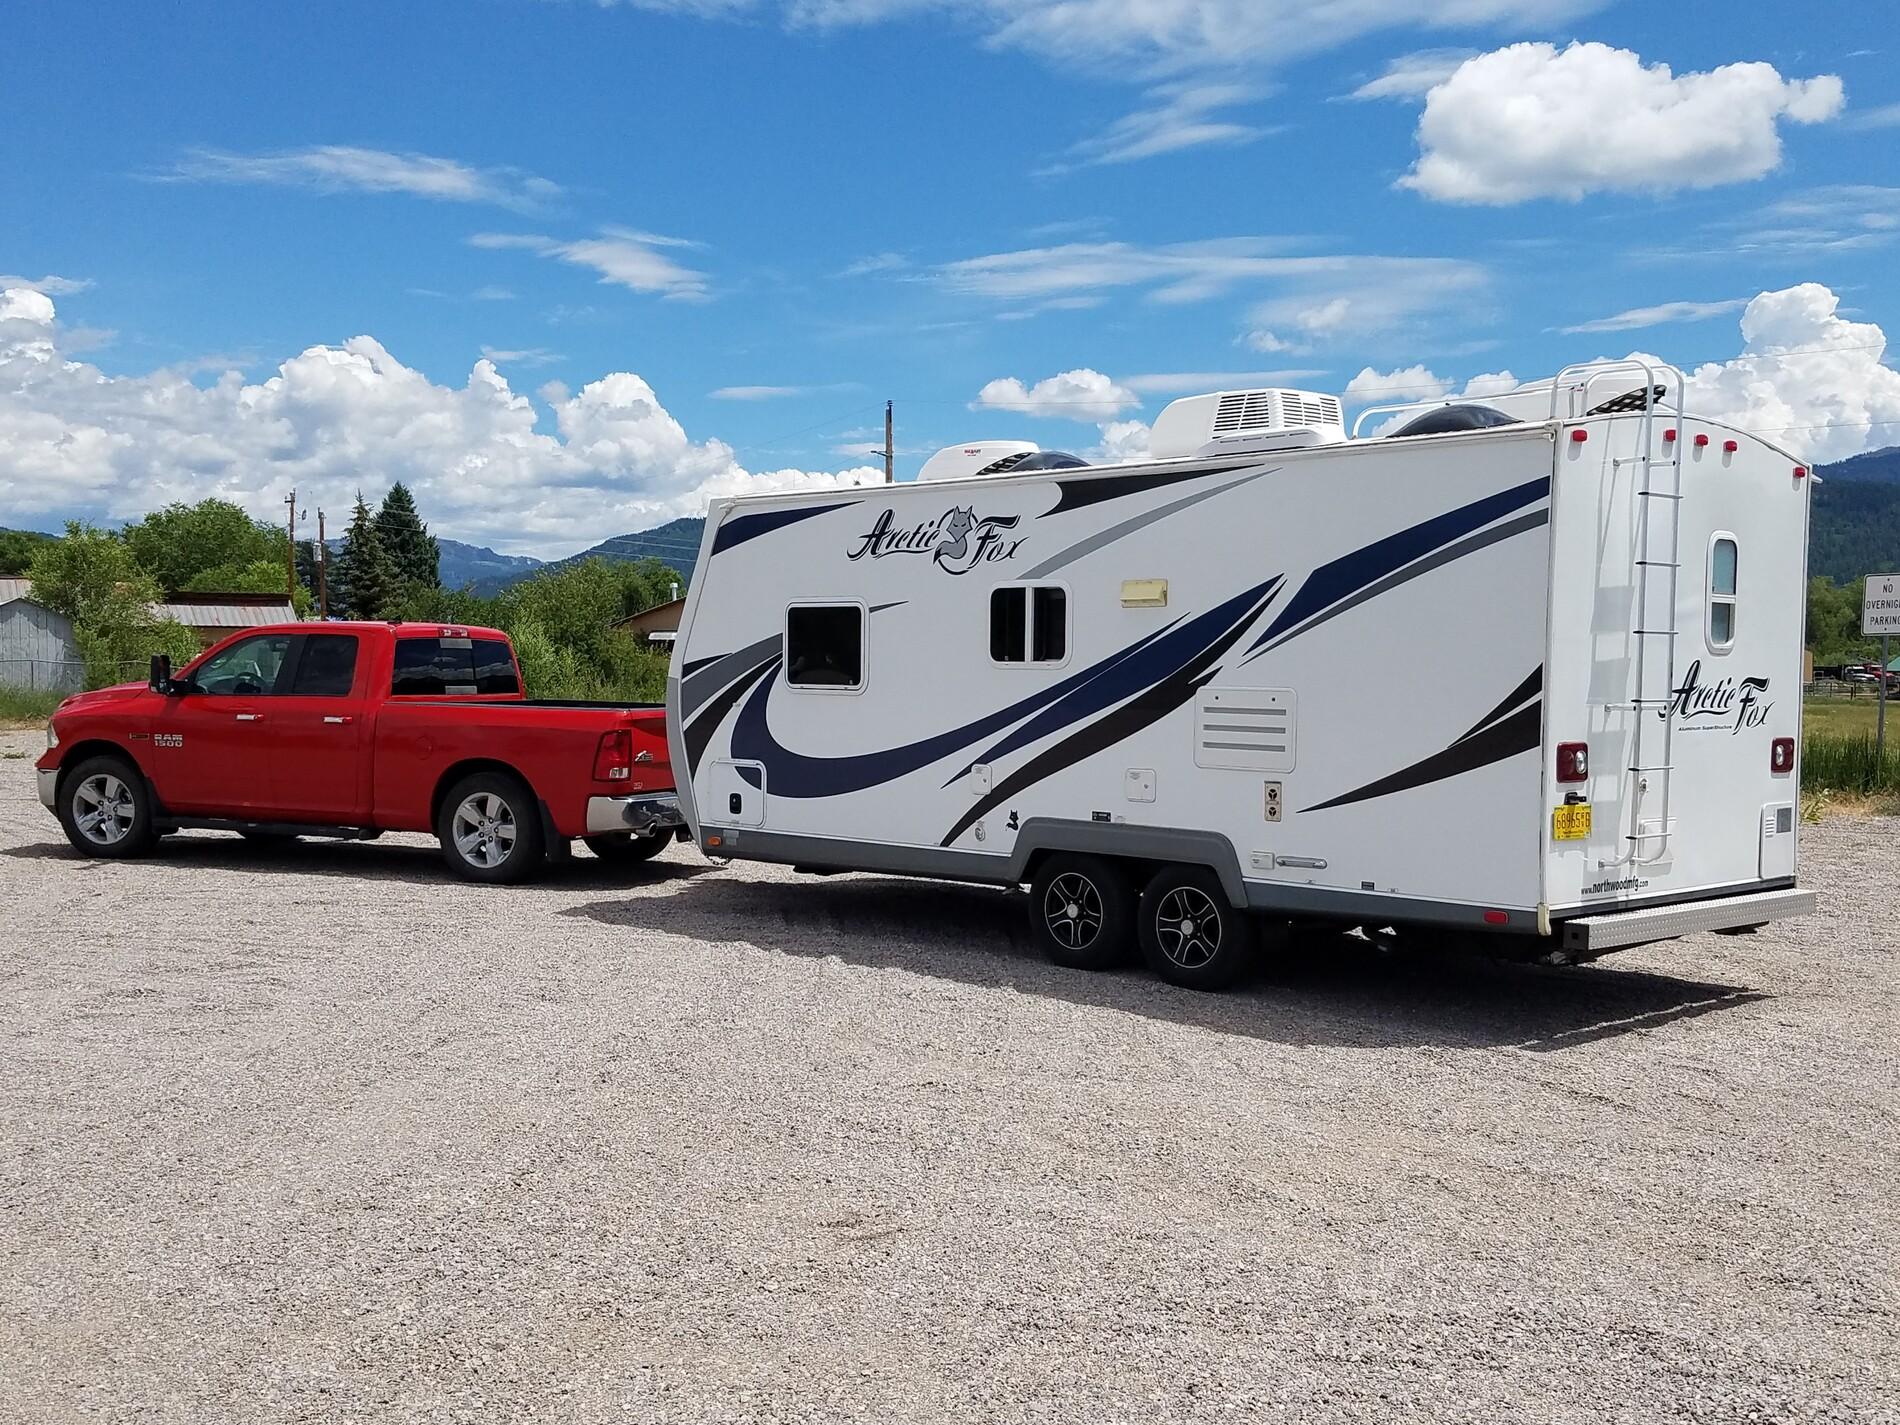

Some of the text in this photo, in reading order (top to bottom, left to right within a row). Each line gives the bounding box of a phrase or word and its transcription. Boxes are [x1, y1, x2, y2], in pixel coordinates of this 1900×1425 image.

[847, 509, 1030, 569] Arctic Fox
[1866, 599, 1900, 609] OVERNIG
[1882, 583, 1894, 593] NO
[1658, 659, 1776, 735] Arctic Fox
